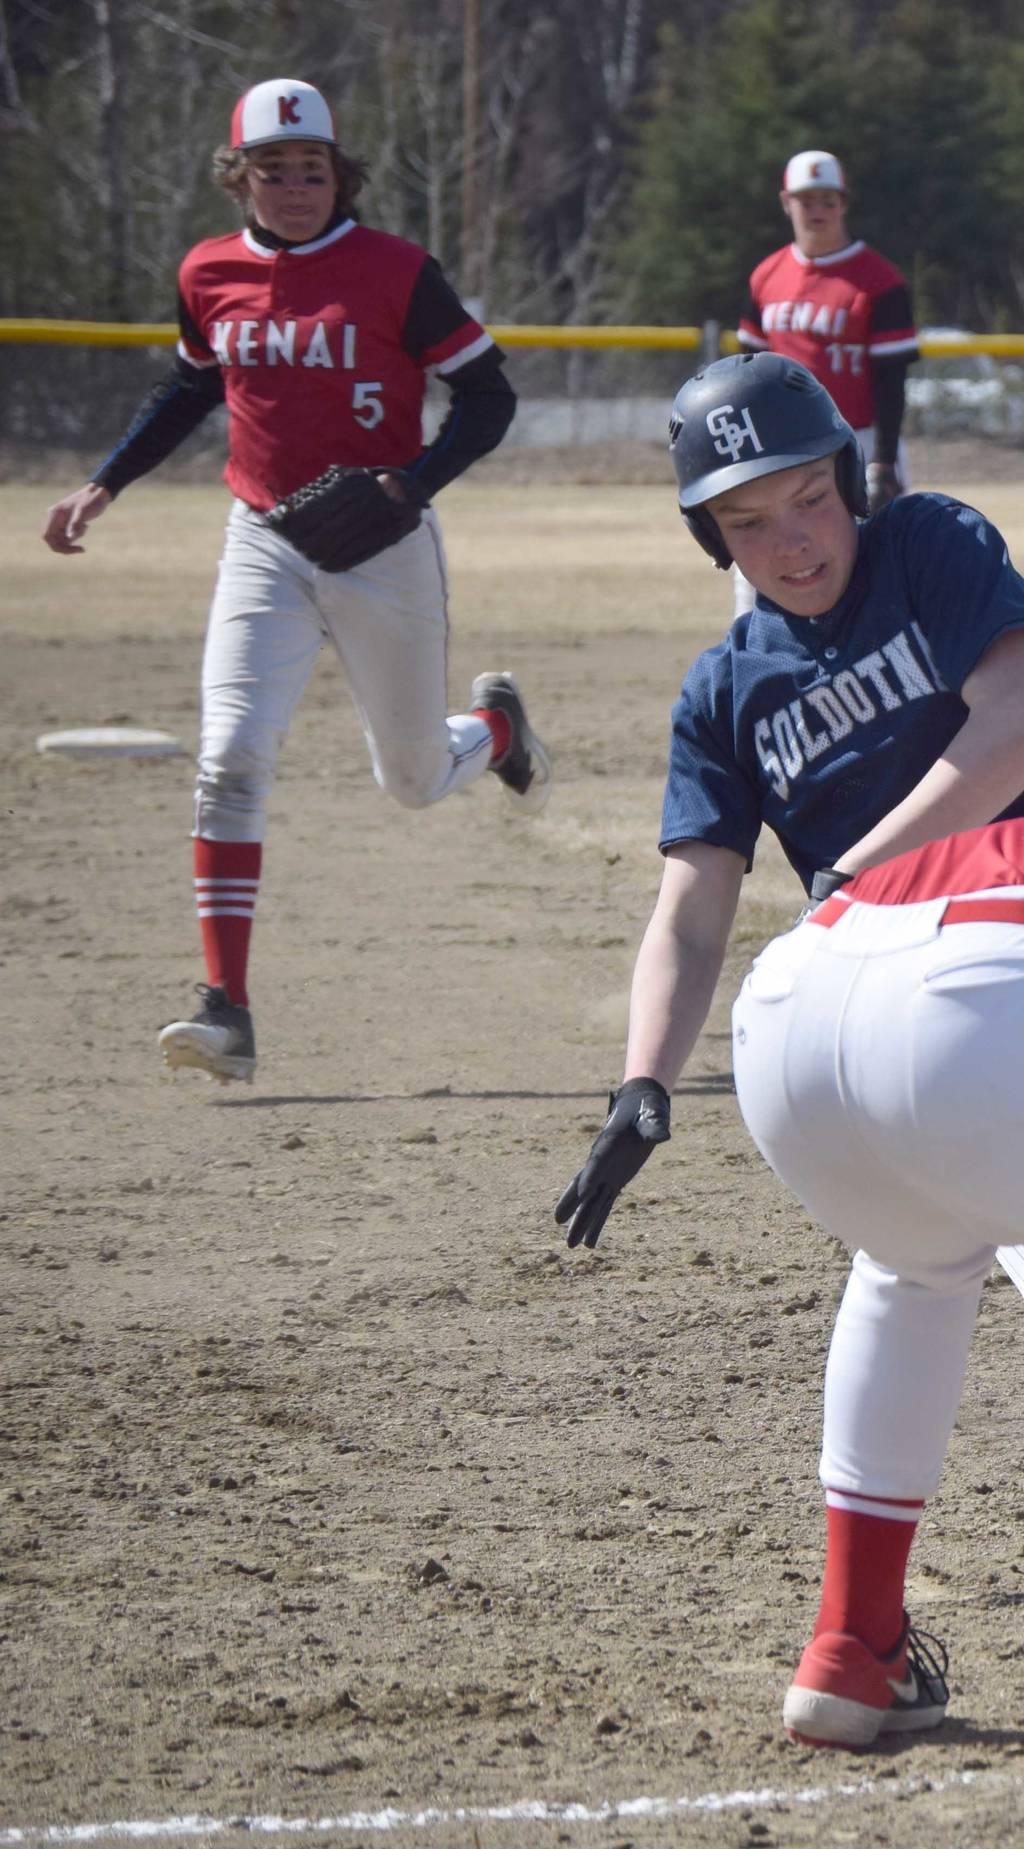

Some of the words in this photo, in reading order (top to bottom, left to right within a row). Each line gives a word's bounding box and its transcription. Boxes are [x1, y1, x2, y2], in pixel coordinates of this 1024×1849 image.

[278, 95, 302, 125] K
[211, 319, 357, 369] KENAI
[825, 344, 865, 376] 17
[352, 381, 385, 430] 5
